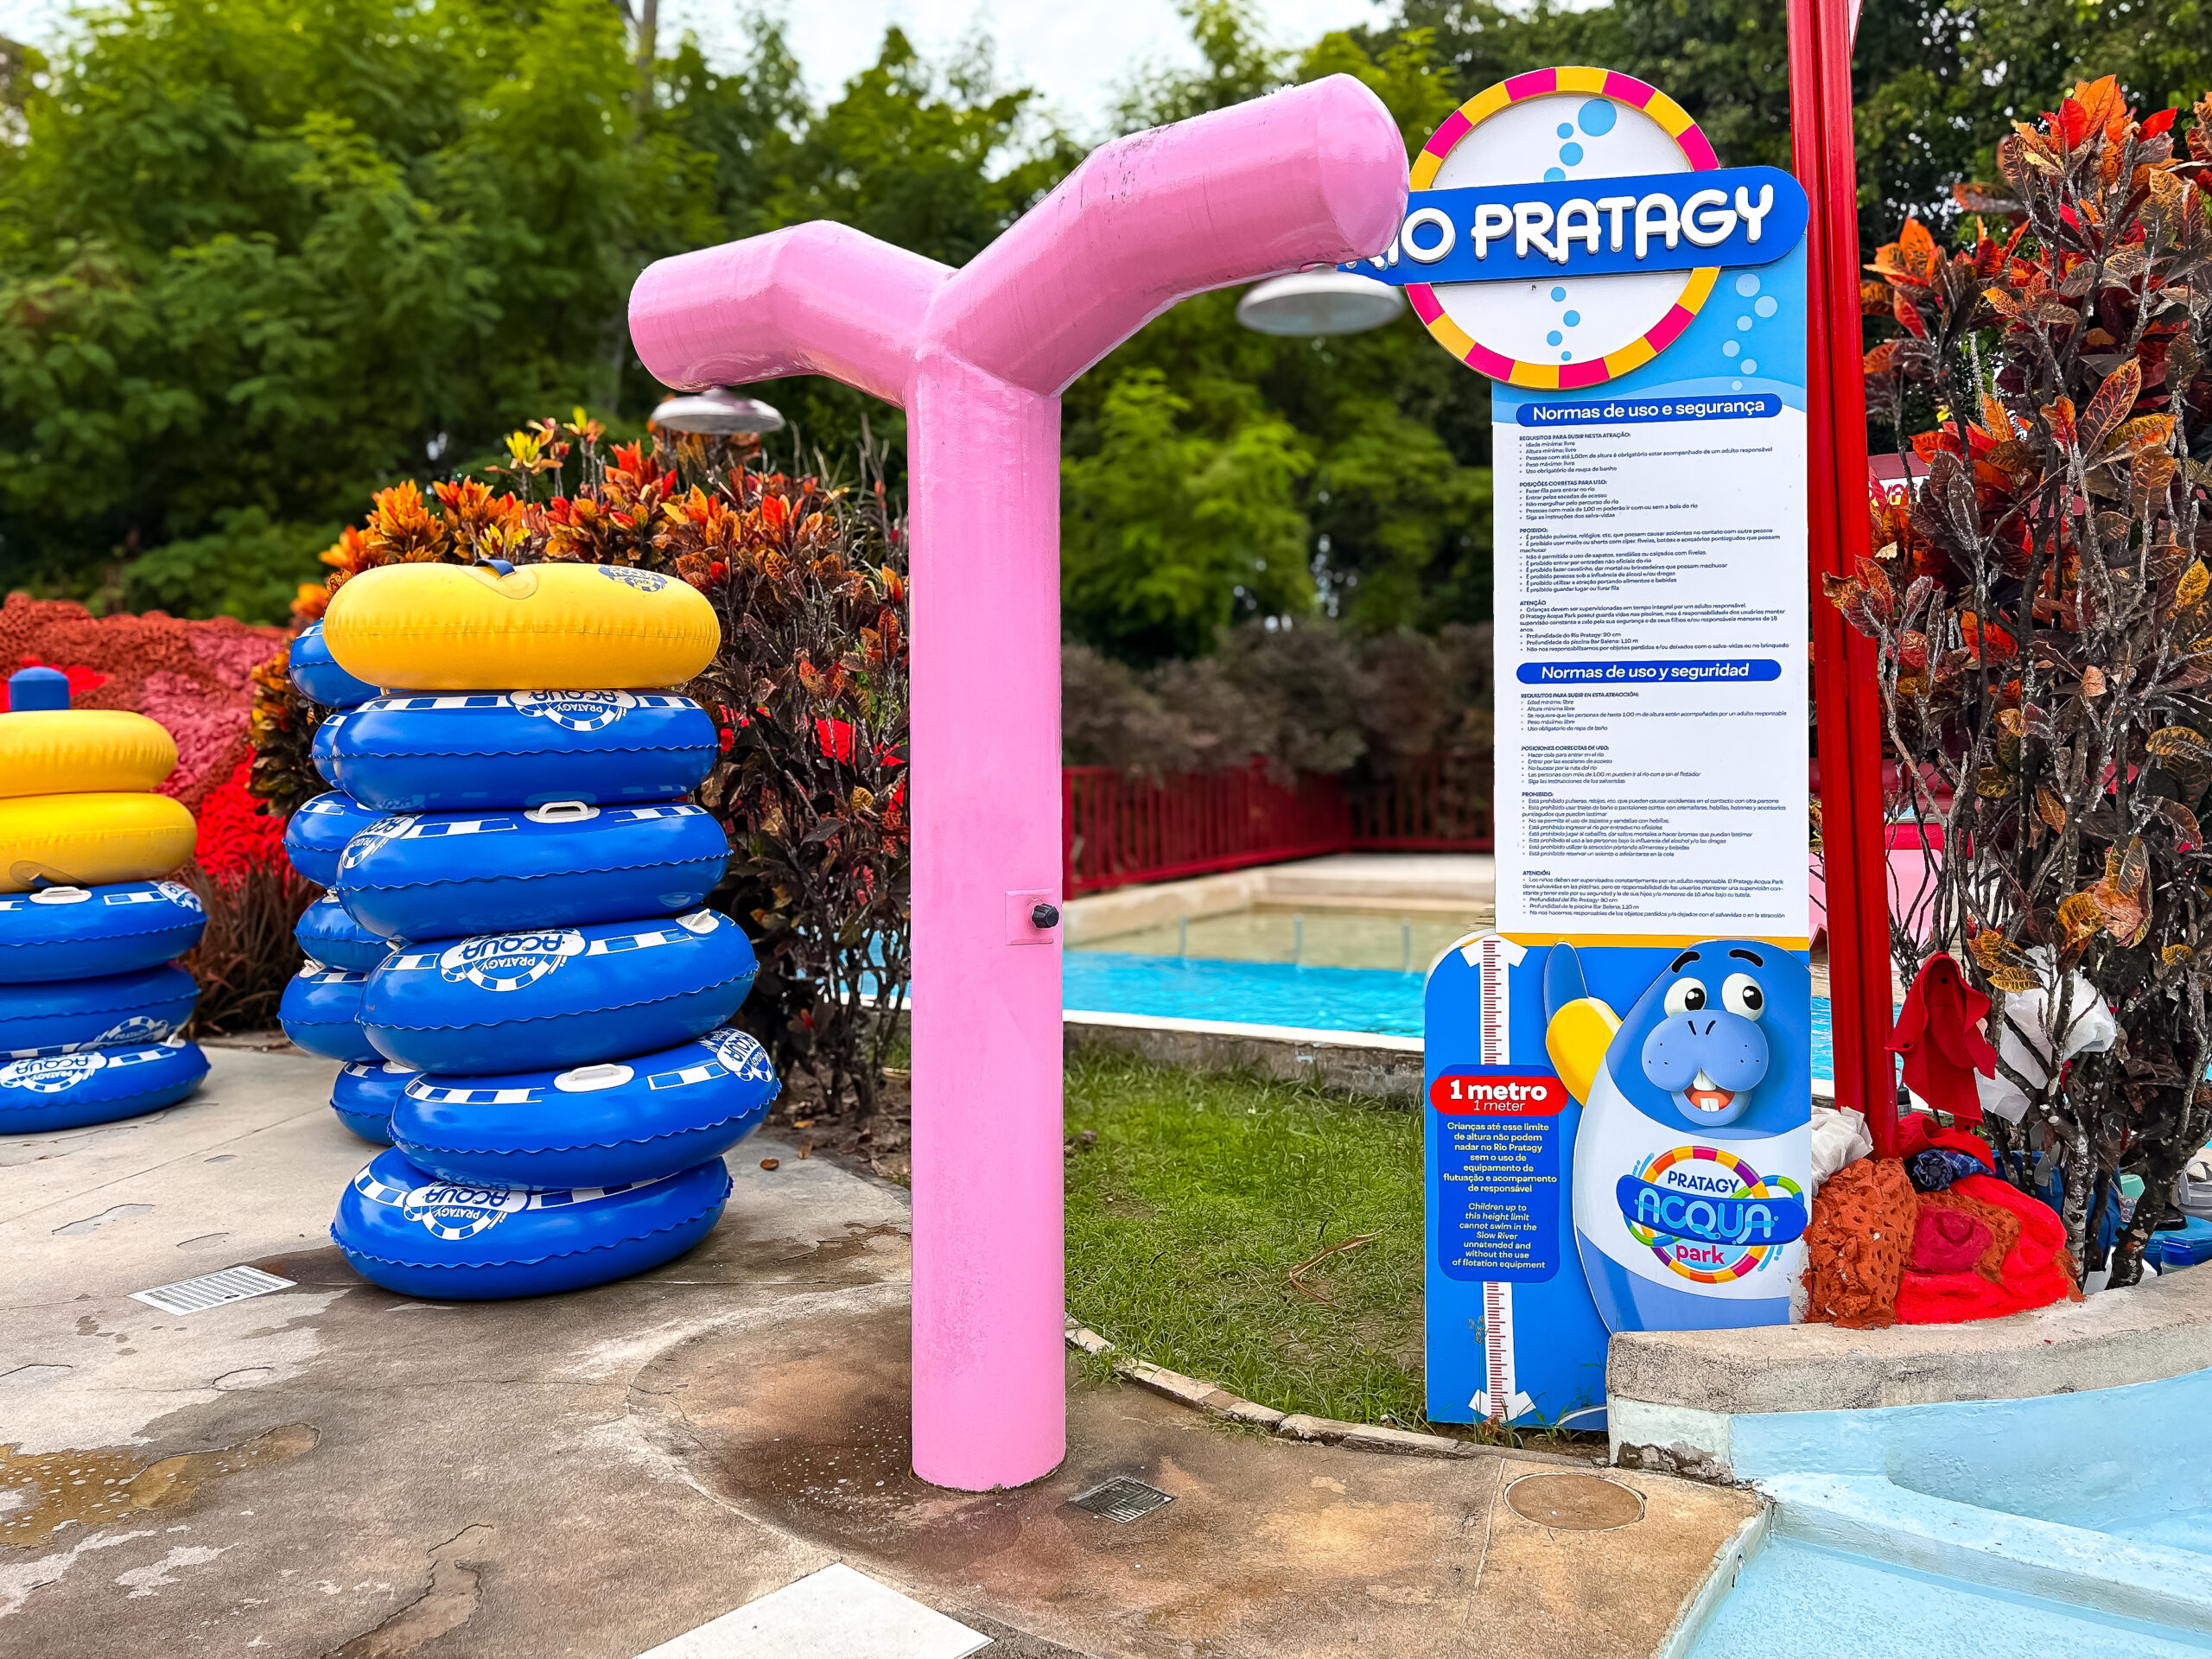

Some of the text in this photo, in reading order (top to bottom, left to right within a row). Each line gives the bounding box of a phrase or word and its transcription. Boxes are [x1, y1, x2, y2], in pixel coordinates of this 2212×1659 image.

[1471, 184, 1775, 265] PRATAGY
[1533, 400, 1765, 420] Normas de uso e segurança
[1541, 662, 1750, 681] Normas de uso y seguridad
[556, 703, 603, 713] PRATAGY
[458, 935, 565, 959] ACQUA
[480, 956, 537, 971] PRATAGY
[16, 1057, 89, 1074] ACQUA
[1450, 1079, 1548, 1101] 1 metro
[1473, 1100, 1525, 1111] 1 meter
[1447, 1122, 1485, 1132] Crianças
[1510, 1144, 1542, 1154] Pratagy
[1464, 1164, 1521, 1173] equipamento
[1444, 1173, 1484, 1182] flutuação
[1668, 1171, 1740, 1193] PRATAGY
[423, 1187, 510, 1207] ACQUA
[1481, 1185, 1532, 1194] responsável
[434, 1208, 481, 1219] PRATAGY
[1483, 1212, 1510, 1221] height
[1635, 1188, 1778, 1244] ACQUA
[1675, 1243, 1725, 1265] park
[1500, 1261, 1545, 1269] equipment
